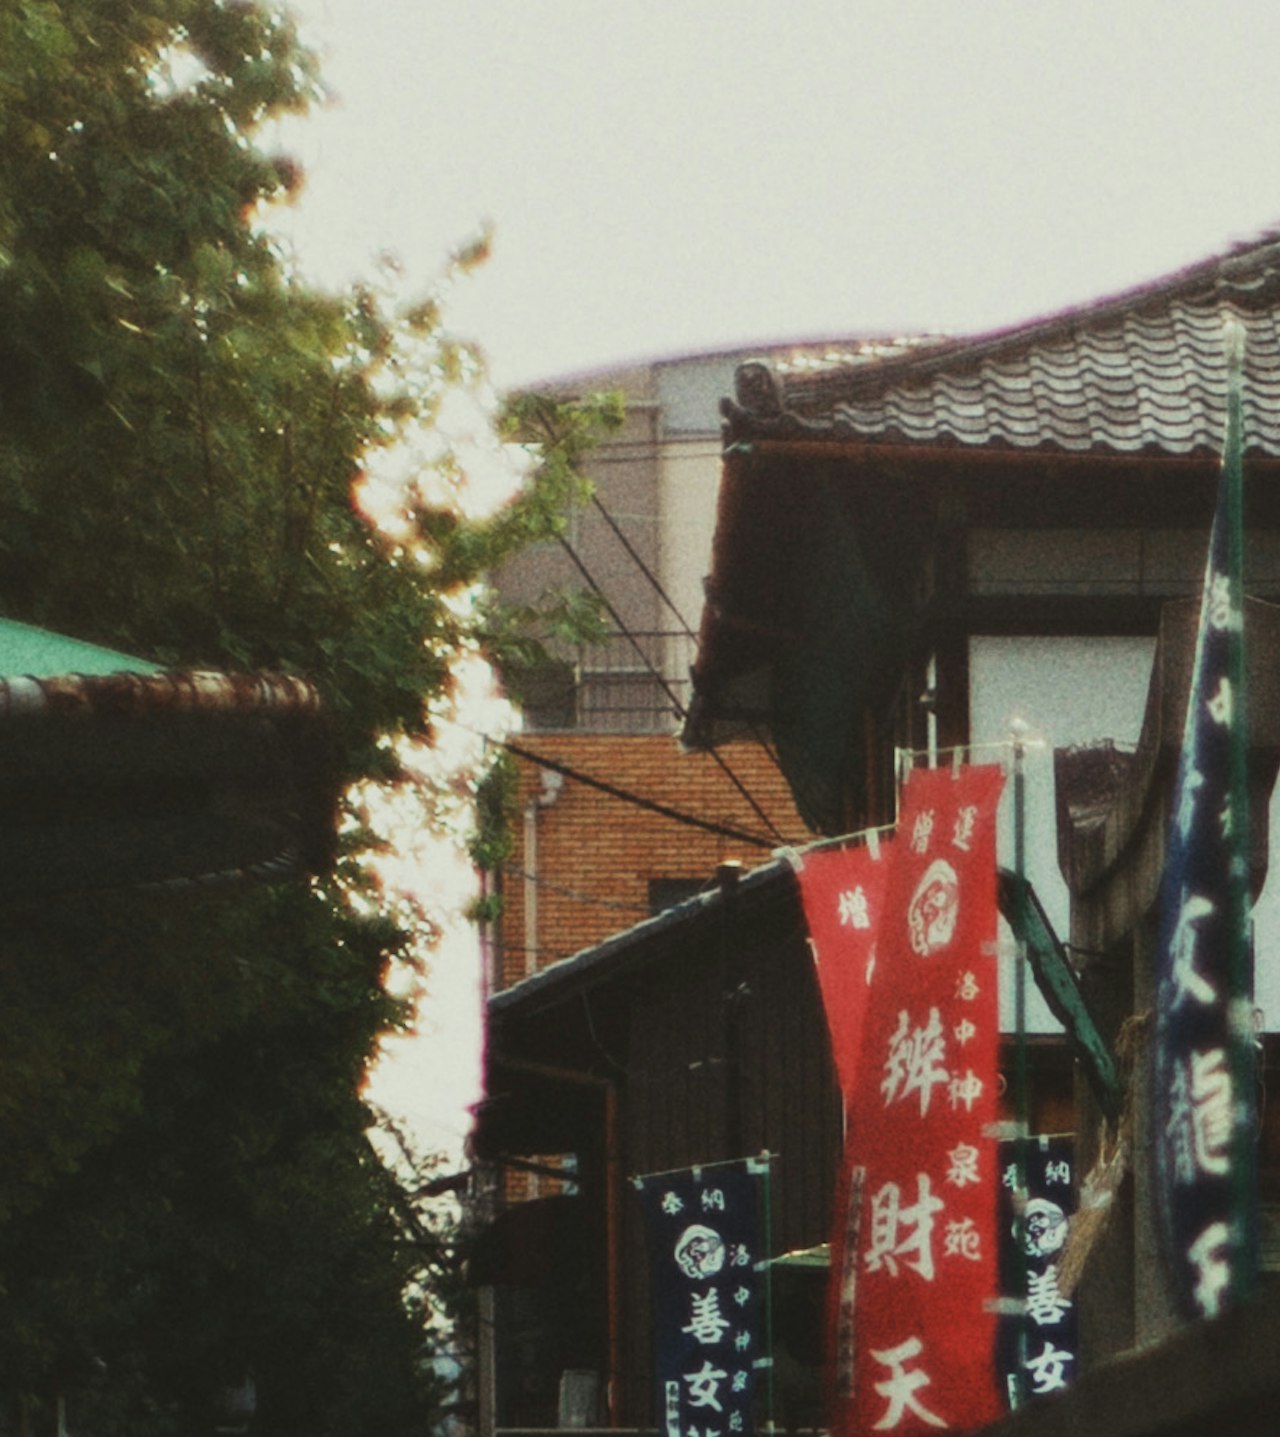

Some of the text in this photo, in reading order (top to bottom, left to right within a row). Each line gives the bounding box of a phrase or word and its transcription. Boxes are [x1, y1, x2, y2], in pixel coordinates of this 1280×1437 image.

[943, 969, 984, 1261] 洛中神泉苑
[660, 1188, 726, 1215] 奉納
[1025, 1265, 1075, 1395] 善女
